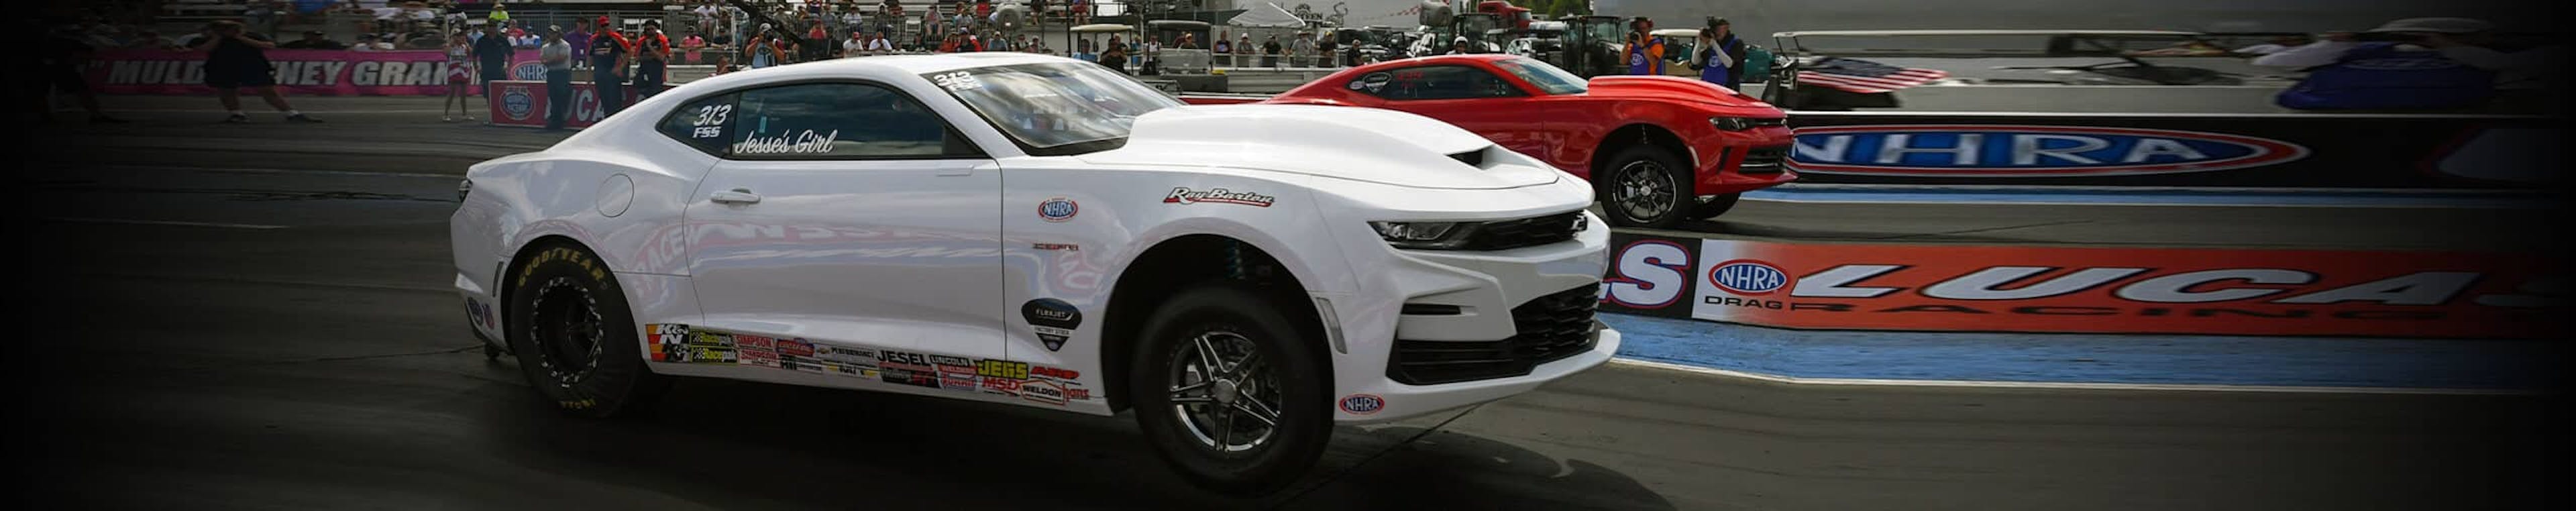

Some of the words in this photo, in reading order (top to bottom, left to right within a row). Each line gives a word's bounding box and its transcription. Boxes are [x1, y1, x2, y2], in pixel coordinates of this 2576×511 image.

[107, 60, 347, 85] MULDNEY
[353, 60, 482, 85] GRAN
[515, 66, 547, 80] NHR
[693, 104, 732, 126] 313
[692, 126, 722, 138] FSS
[735, 129, 790, 154] Jesse's
[794, 129, 839, 154] Girl
[1791, 134, 2208, 166] NHRA
[1044, 202, 1072, 216] NHRA
[517, 247, 606, 287] GOODYEAR
[1720, 266, 1778, 290] NHRA
[1705, 296, 1782, 310] DRAG
[1790, 303, 2447, 319] RACING
[737, 335, 771, 347] SIMPSON
[877, 350, 932, 366] JESEL
[977, 359, 1028, 380] JEGS
[982, 378, 1018, 390] MSD
[1022, 385, 1061, 398] WELDON
[1346, 398, 1379, 410] NHRA
